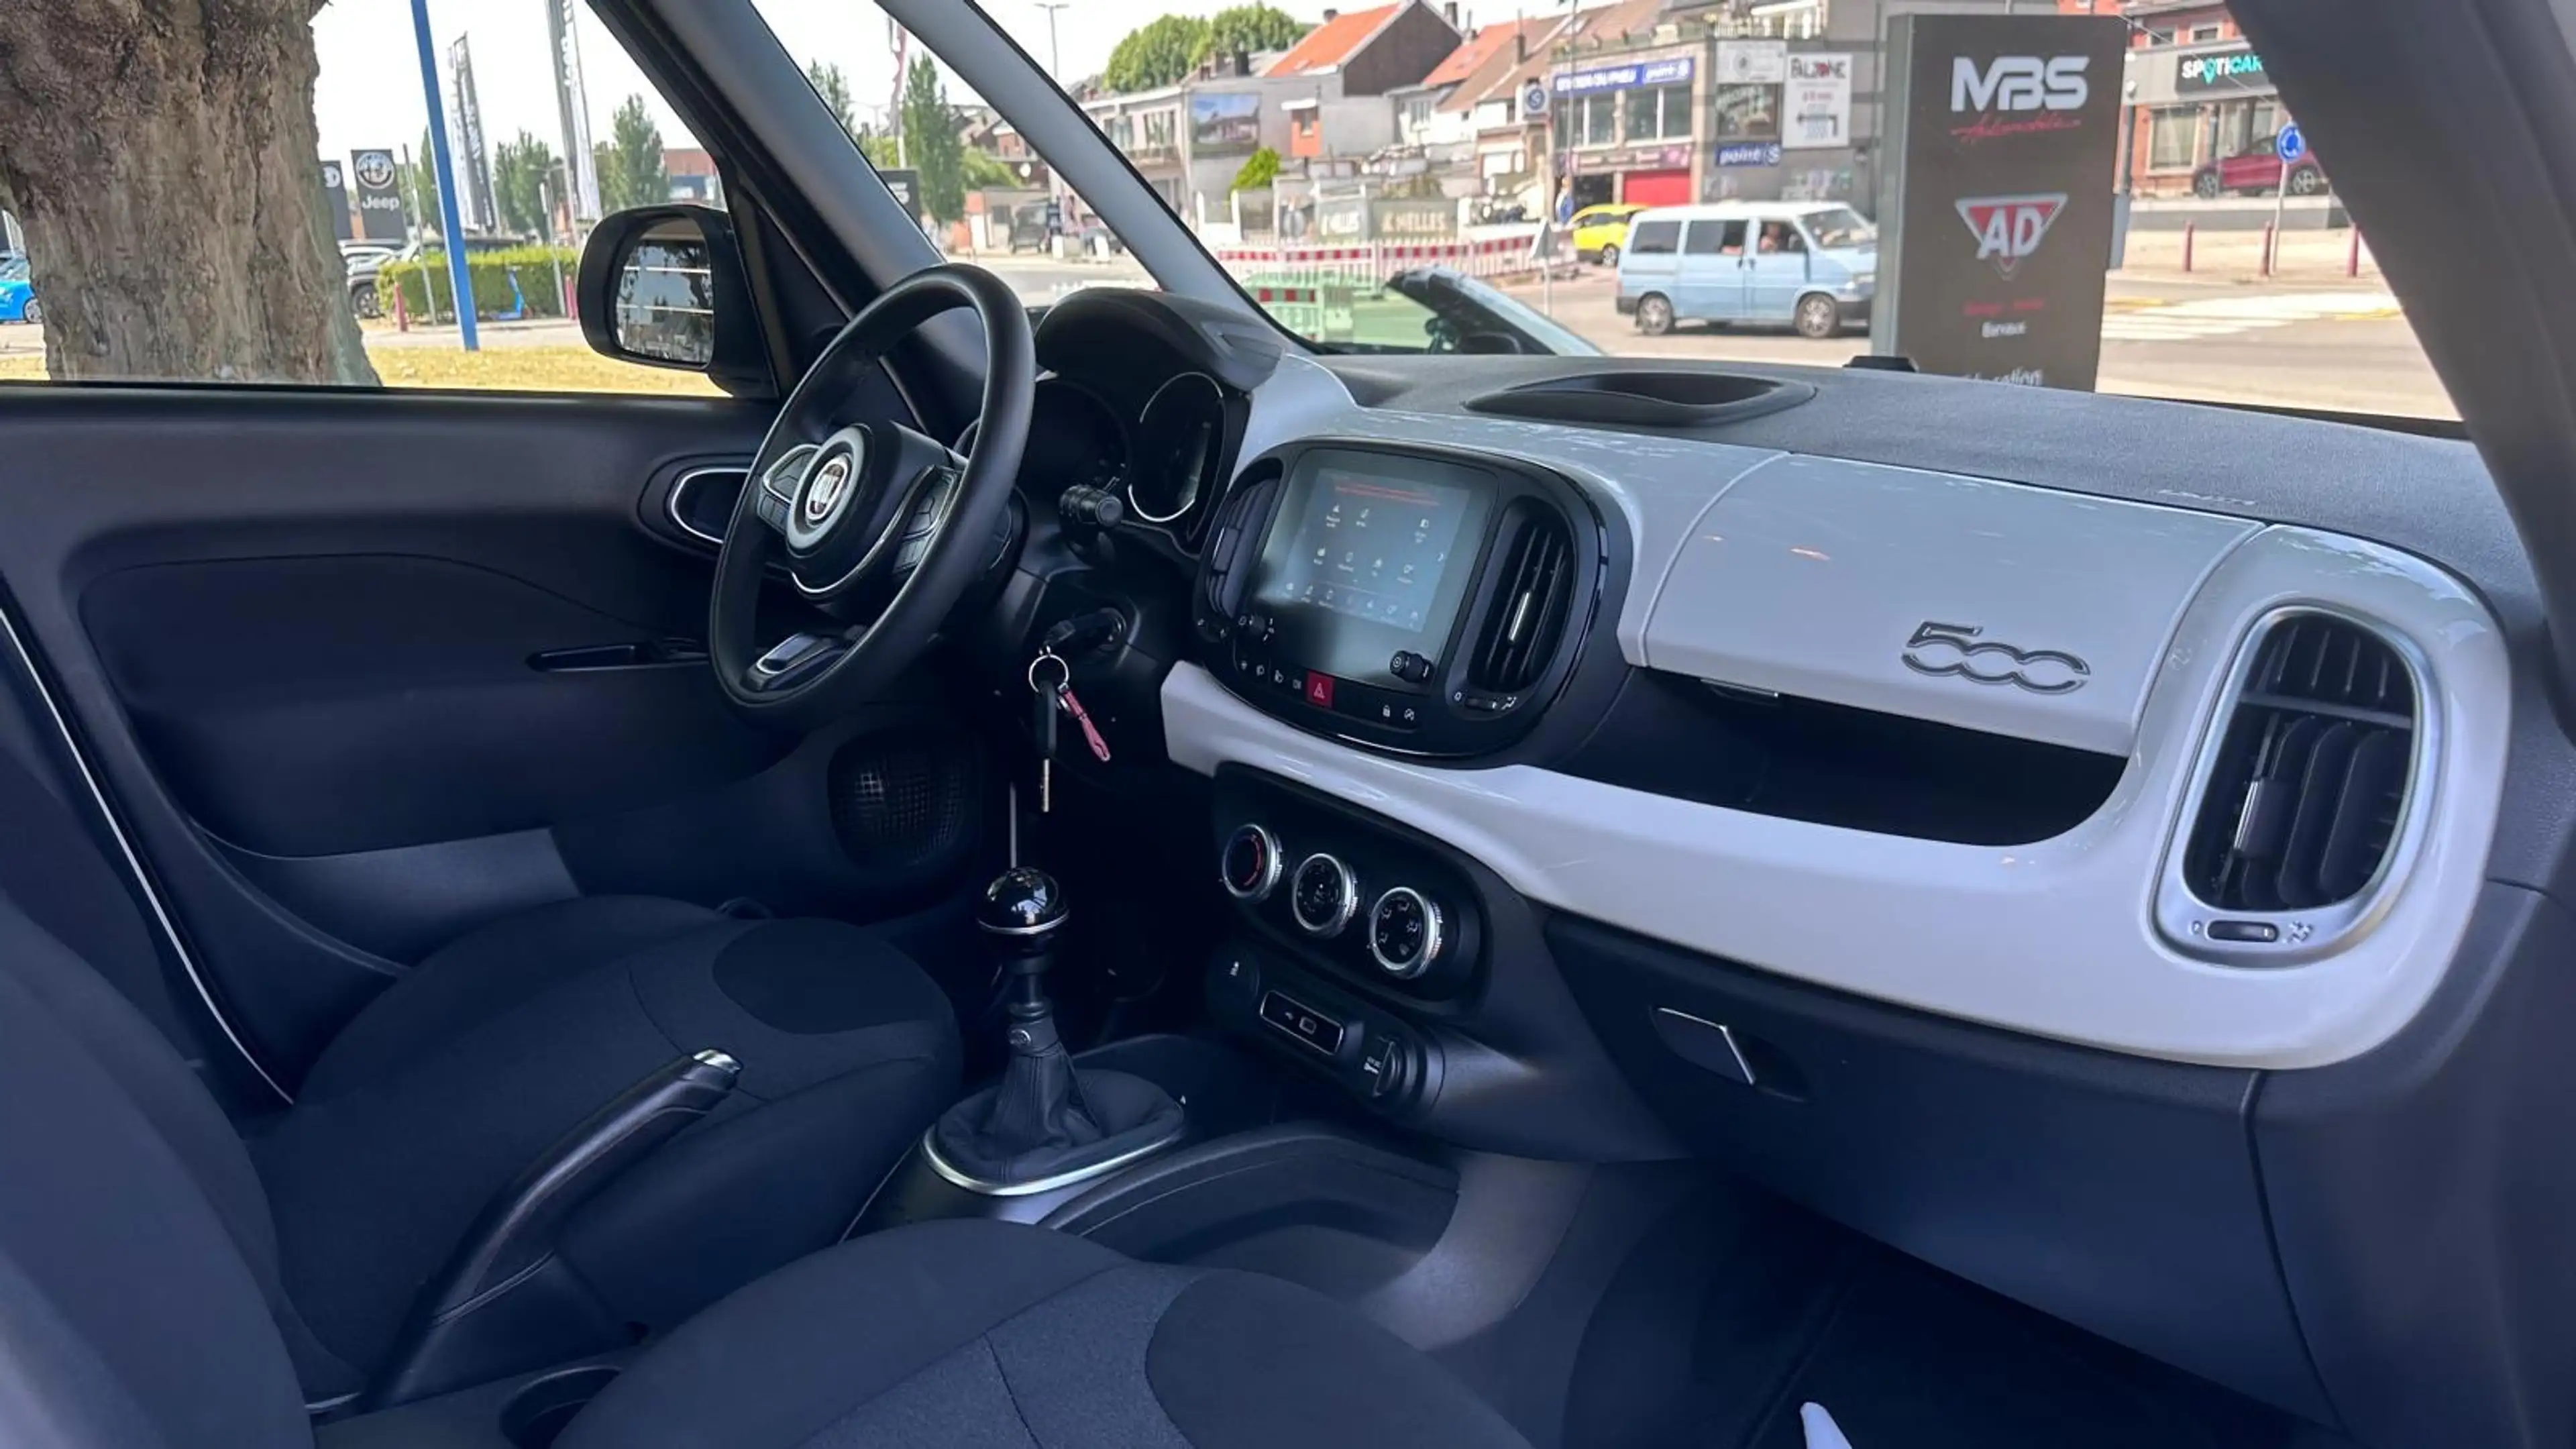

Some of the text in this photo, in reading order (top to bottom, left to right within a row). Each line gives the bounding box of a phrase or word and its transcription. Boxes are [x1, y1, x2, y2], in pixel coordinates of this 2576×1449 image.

[1951, 56, 2090, 111] MBS
[362, 194, 400, 212] Jeep
[1976, 206, 2043, 260] AD
[1901, 620, 2091, 696] 500
